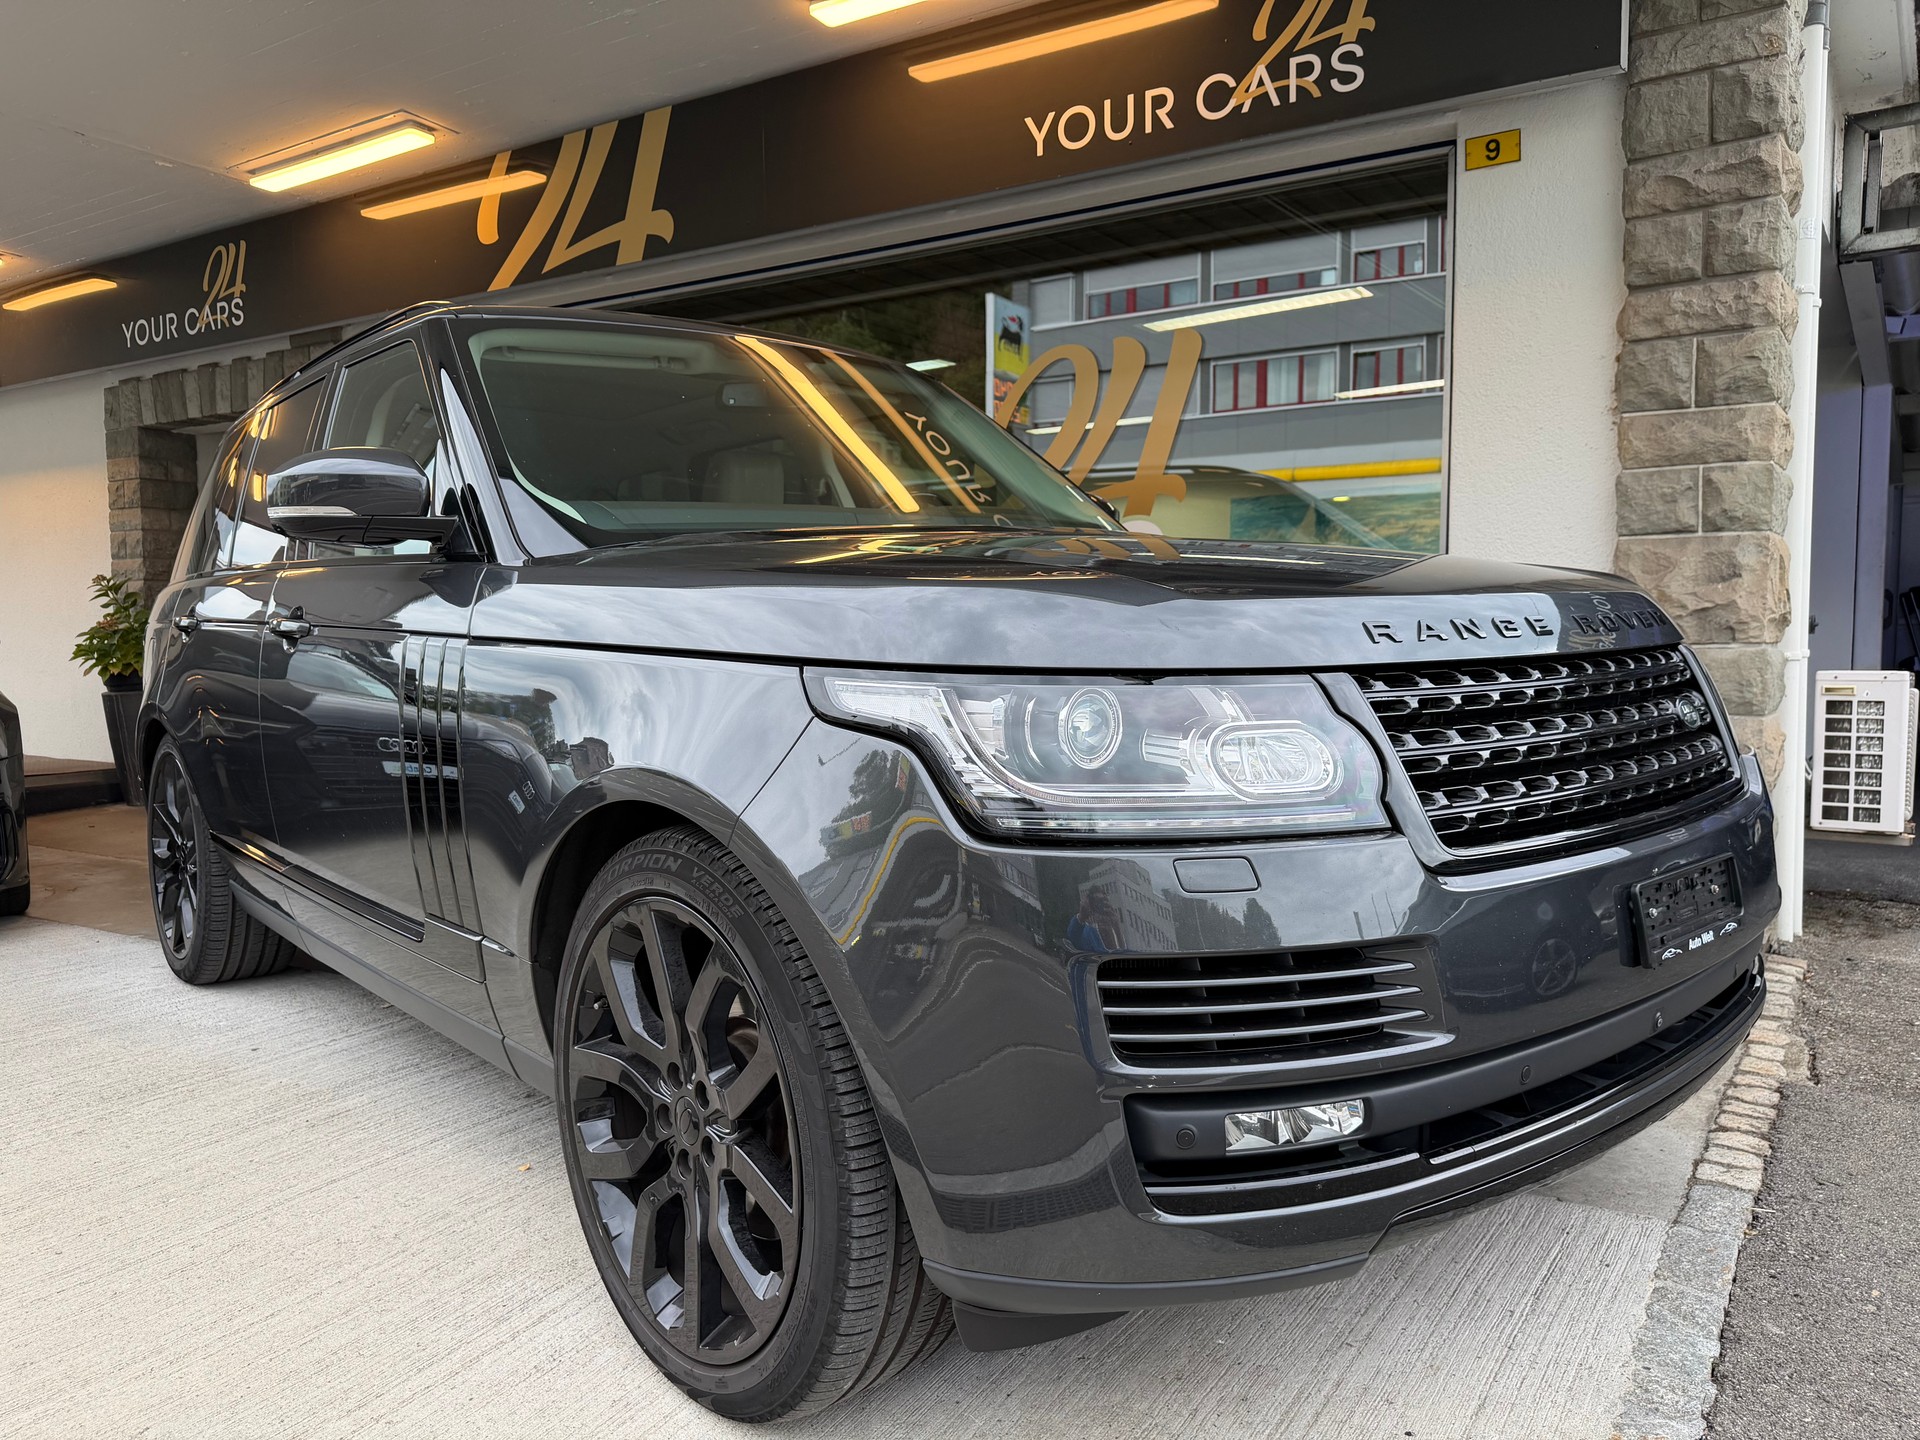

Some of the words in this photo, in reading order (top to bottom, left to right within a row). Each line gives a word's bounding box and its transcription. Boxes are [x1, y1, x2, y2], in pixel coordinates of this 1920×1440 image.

[1023, 86, 1175, 157] YOUR
[1195, 43, 1366, 121] CARS
[1485, 138, 1501, 161] 9
[197, 239, 247, 328] 24
[121, 312, 179, 348] YOUR
[184, 297, 245, 336] CARS
[1361, 615, 1554, 644] RANGE
[1571, 609, 1668, 635] ROVER
[692, 866, 745, 919] VERDE
[1688, 937, 1702, 951] Auto
